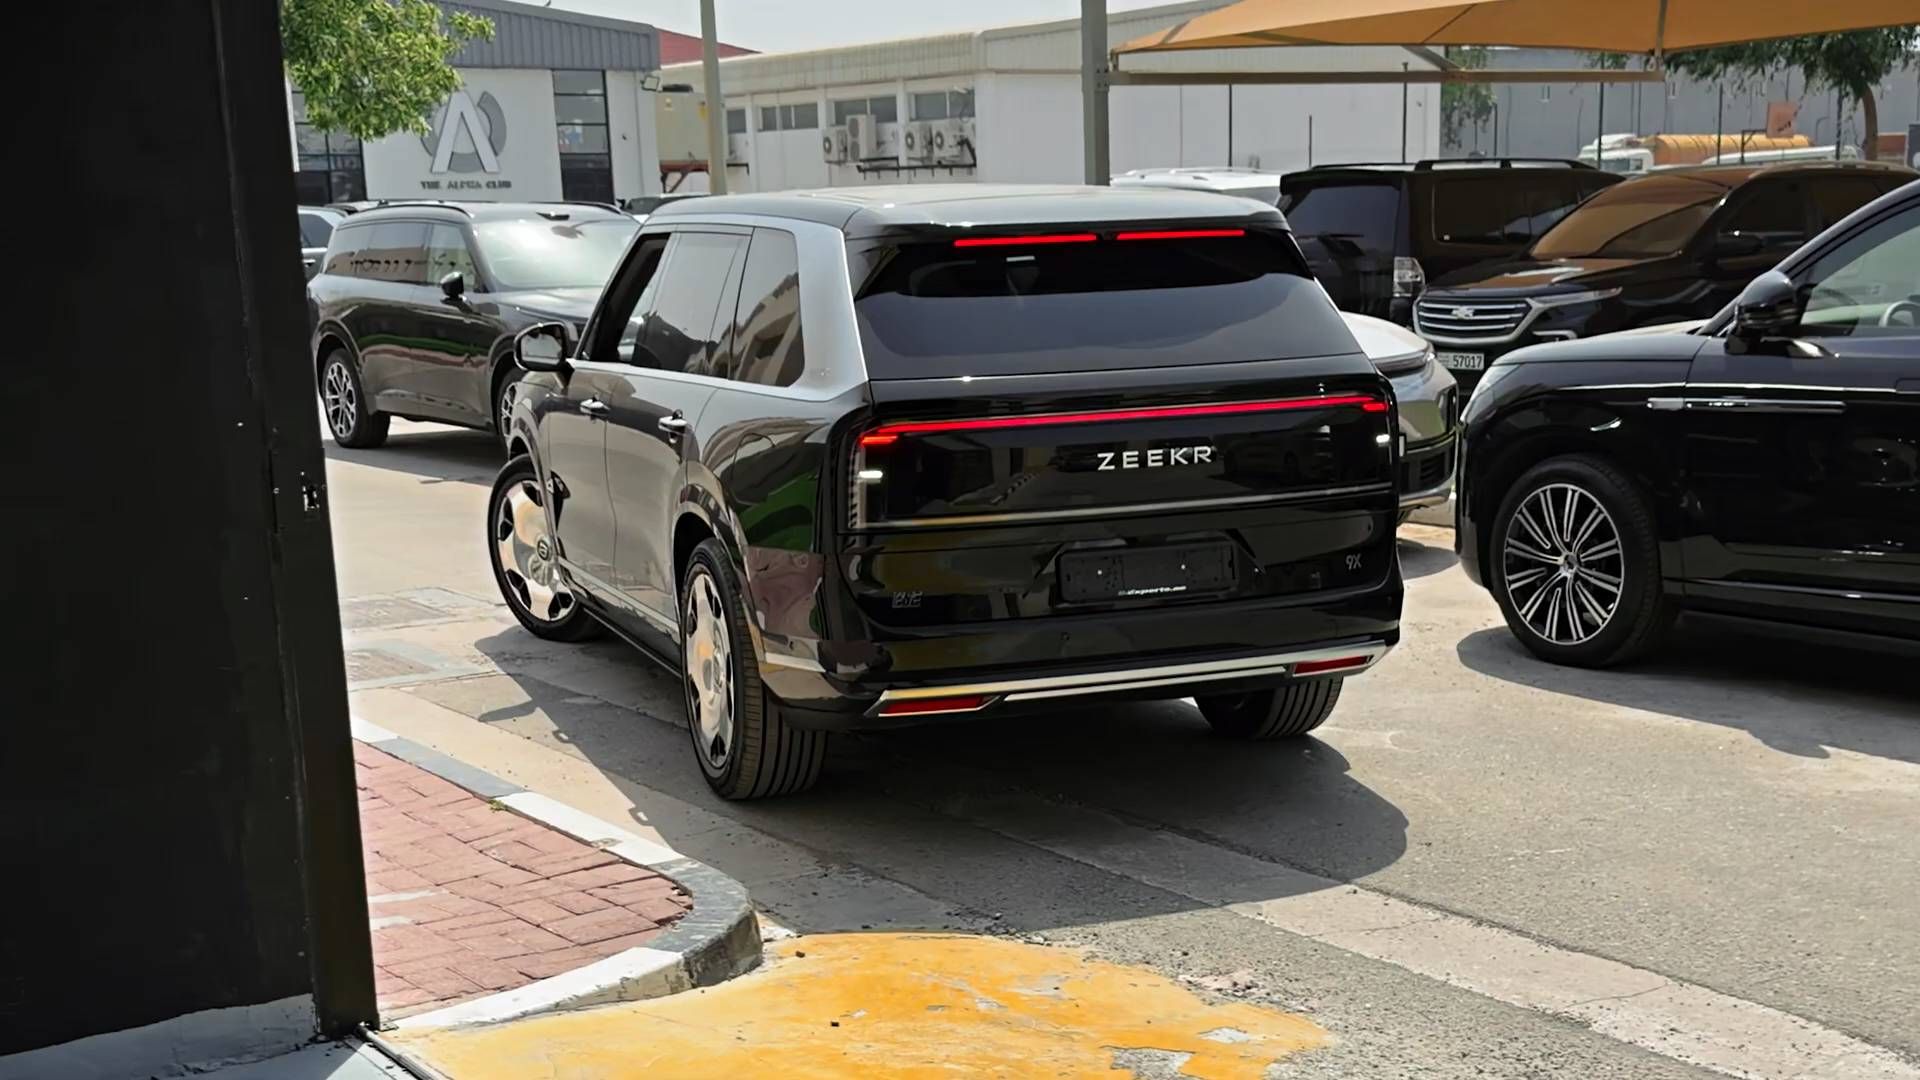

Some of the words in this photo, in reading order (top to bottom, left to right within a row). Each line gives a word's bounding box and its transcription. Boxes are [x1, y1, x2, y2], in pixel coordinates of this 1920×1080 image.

[485, 180, 512, 189] CLUB
[1453, 354, 1483, 368] 57017
[1096, 446, 1212, 471] ZEEKR
[1346, 553, 1362, 570] 9X
